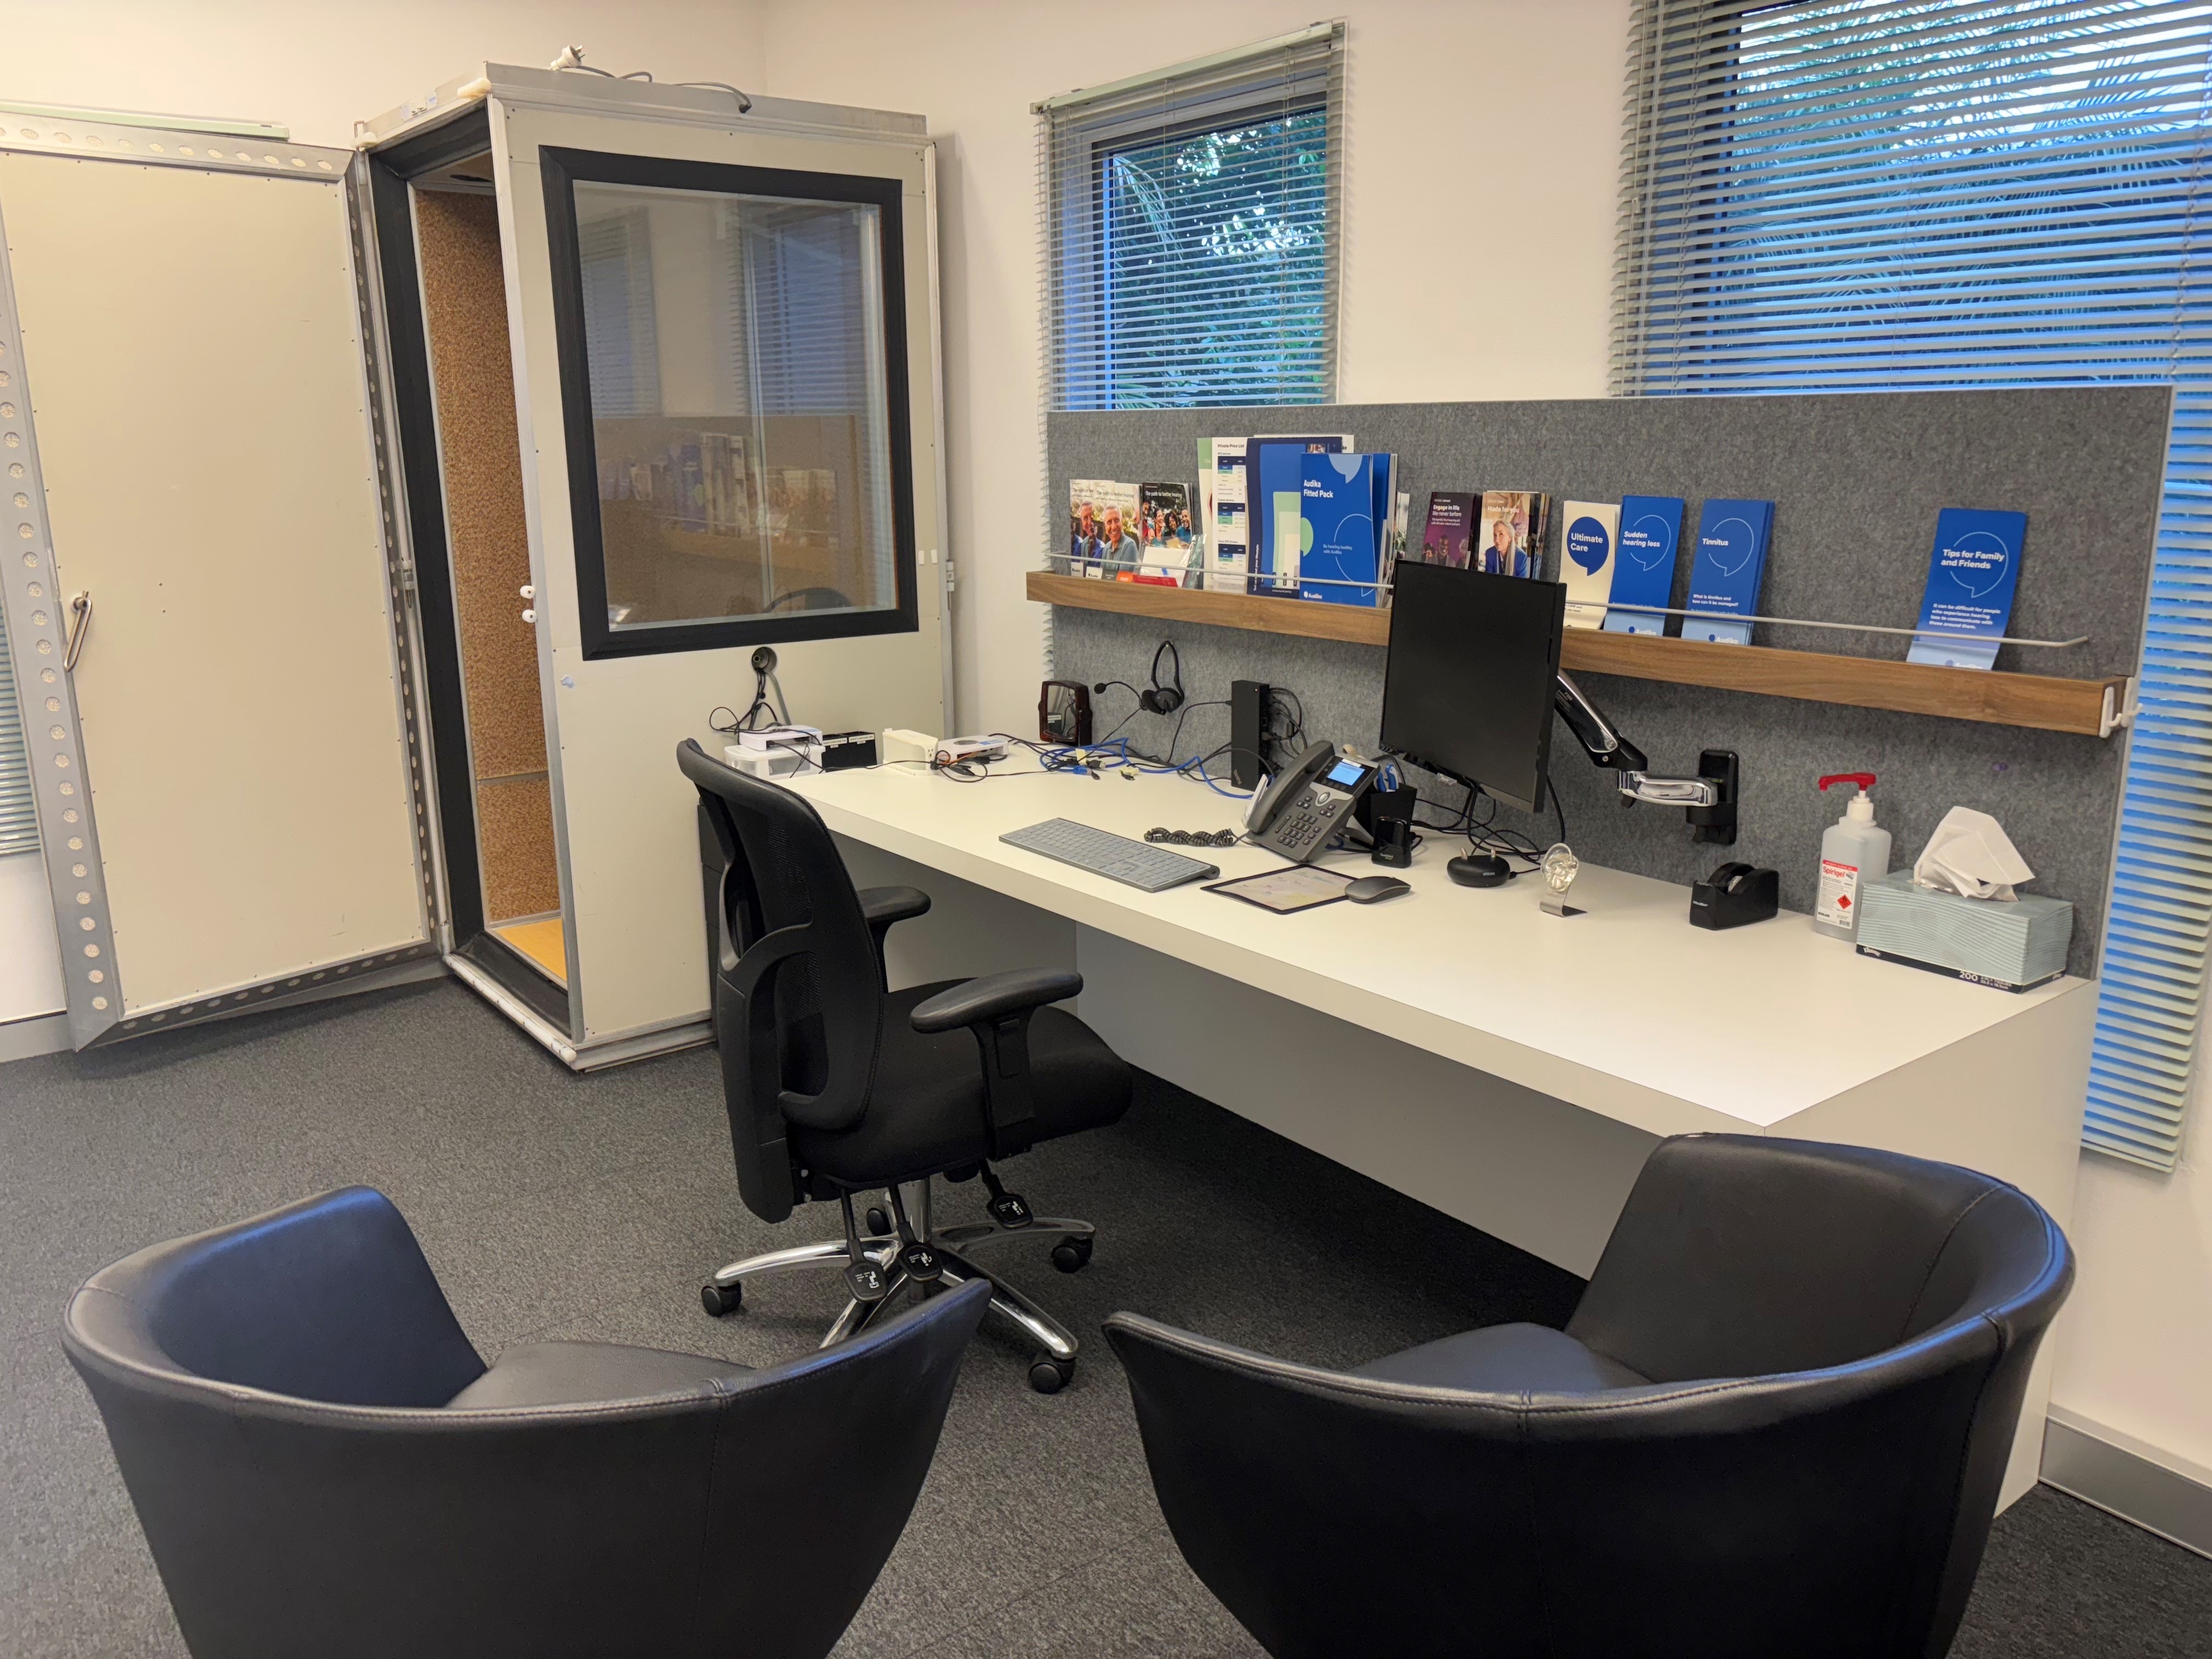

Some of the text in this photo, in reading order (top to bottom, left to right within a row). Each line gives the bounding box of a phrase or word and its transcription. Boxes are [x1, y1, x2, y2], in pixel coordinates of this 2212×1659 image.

[1303, 479, 1321, 488] Audika
[1303, 489, 1333, 498] Fitted Pack
[1571, 532, 1603, 544] Ultimate
[1571, 543, 1589, 552] Care
[1622, 539, 1646, 548] hearing
[1943, 549, 1961, 558] Tips
[1975, 551, 2005, 562] Family
[1958, 560, 1991, 569] Friends
[1715, 636, 1739, 645] Audika
[1822, 866, 1845, 878] Spirigel
[1959, 970, 1979, 981] 200
